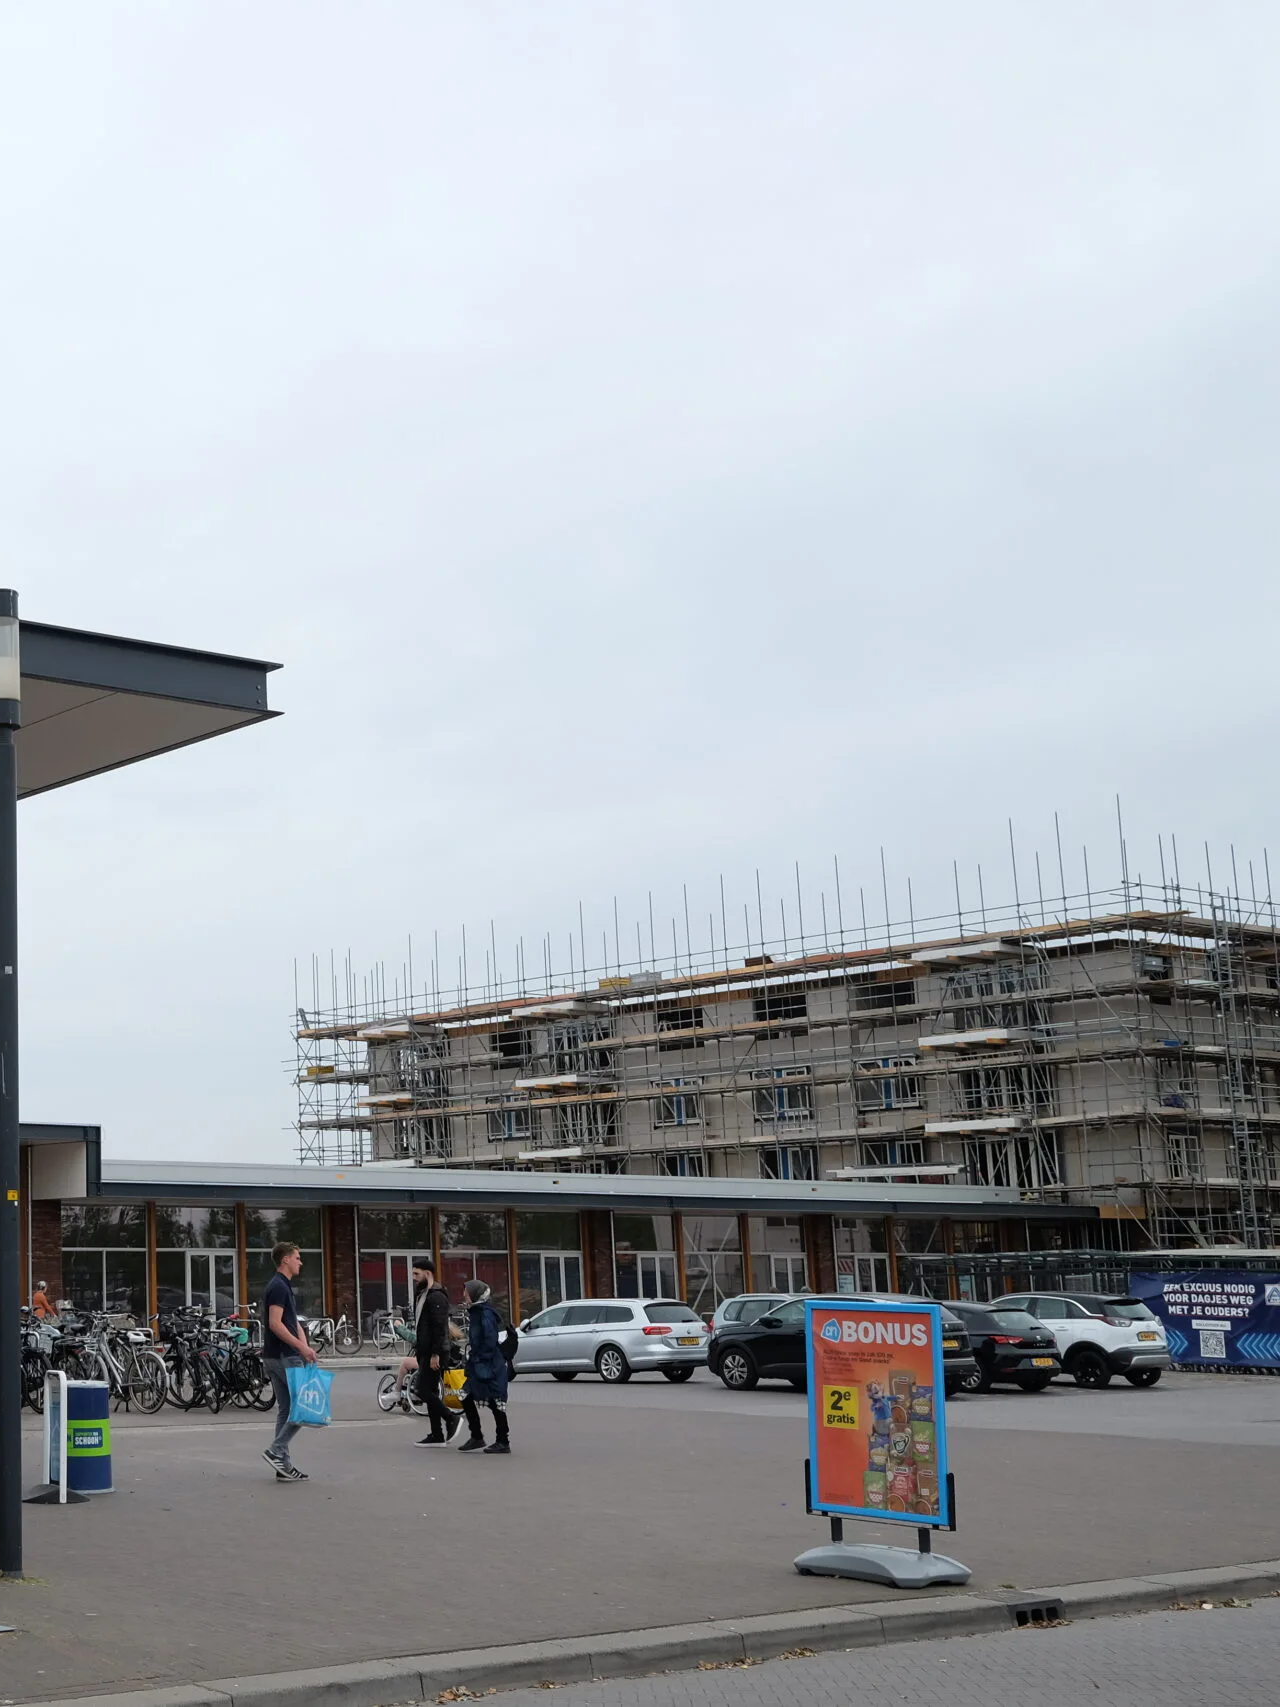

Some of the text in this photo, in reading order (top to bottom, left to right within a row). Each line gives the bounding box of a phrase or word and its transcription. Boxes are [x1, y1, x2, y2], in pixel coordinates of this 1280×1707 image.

[1183, 1283, 1223, 1294] EXCUUS
[1224, 1284, 1256, 1294] NODIG
[1163, 1293, 1254, 1305] VOOR DAGJES WEG
[1168, 1305, 1250, 1317] MET JE OUDERS?
[841, 1320, 928, 1347] BONUS
[826, 1413, 855, 1424] gratis
